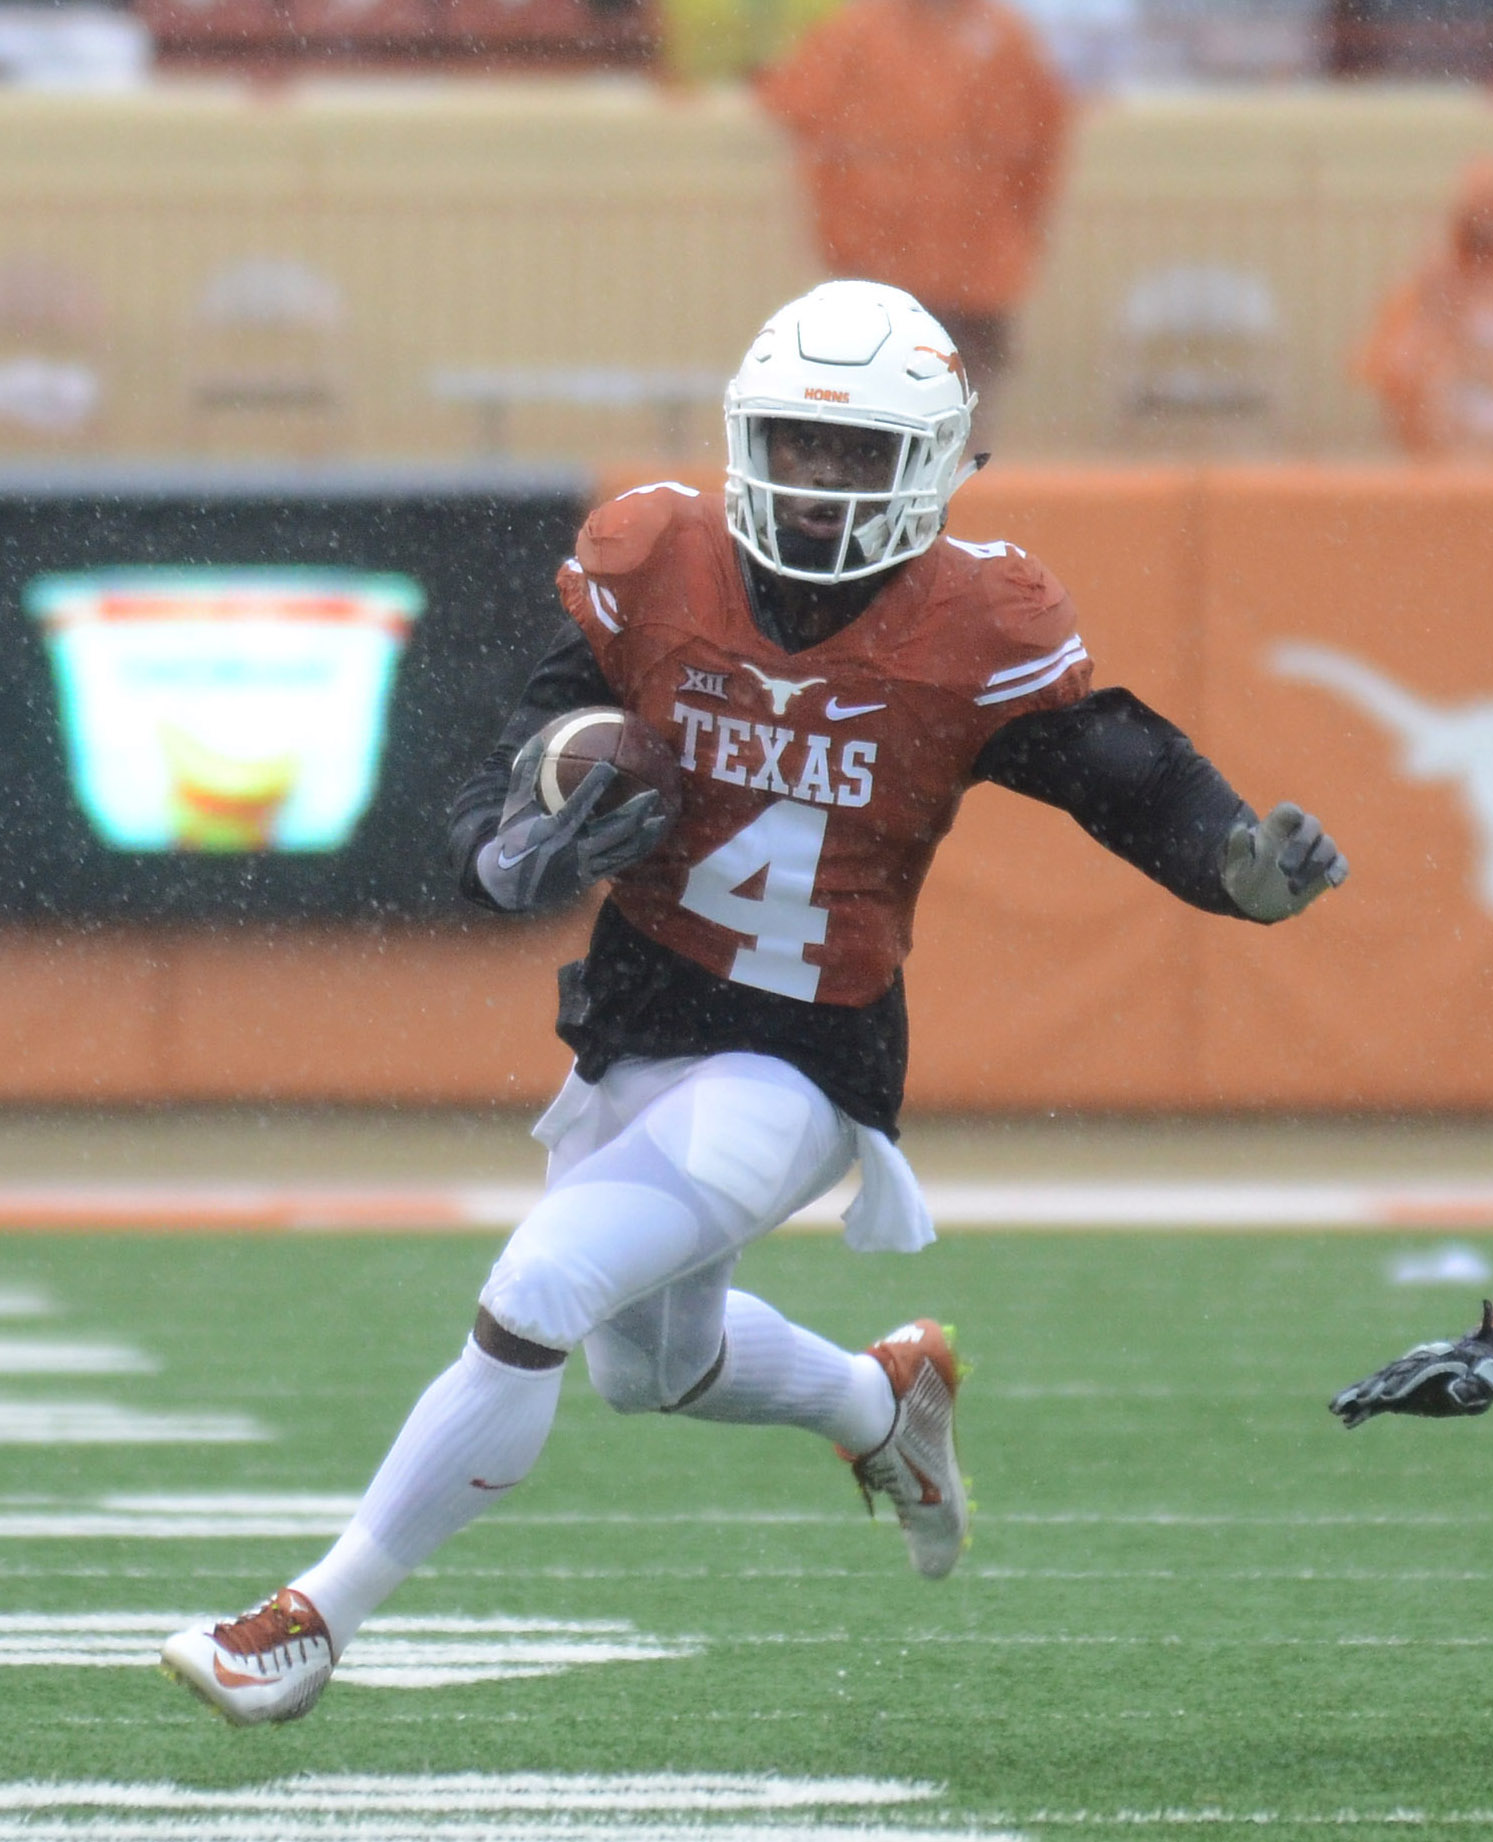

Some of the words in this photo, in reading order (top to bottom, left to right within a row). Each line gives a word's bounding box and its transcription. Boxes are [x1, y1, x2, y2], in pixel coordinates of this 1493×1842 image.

[804, 387, 850, 404] HORNS
[673, 701, 878, 808] TEXAS
[679, 799, 830, 1004] 4
